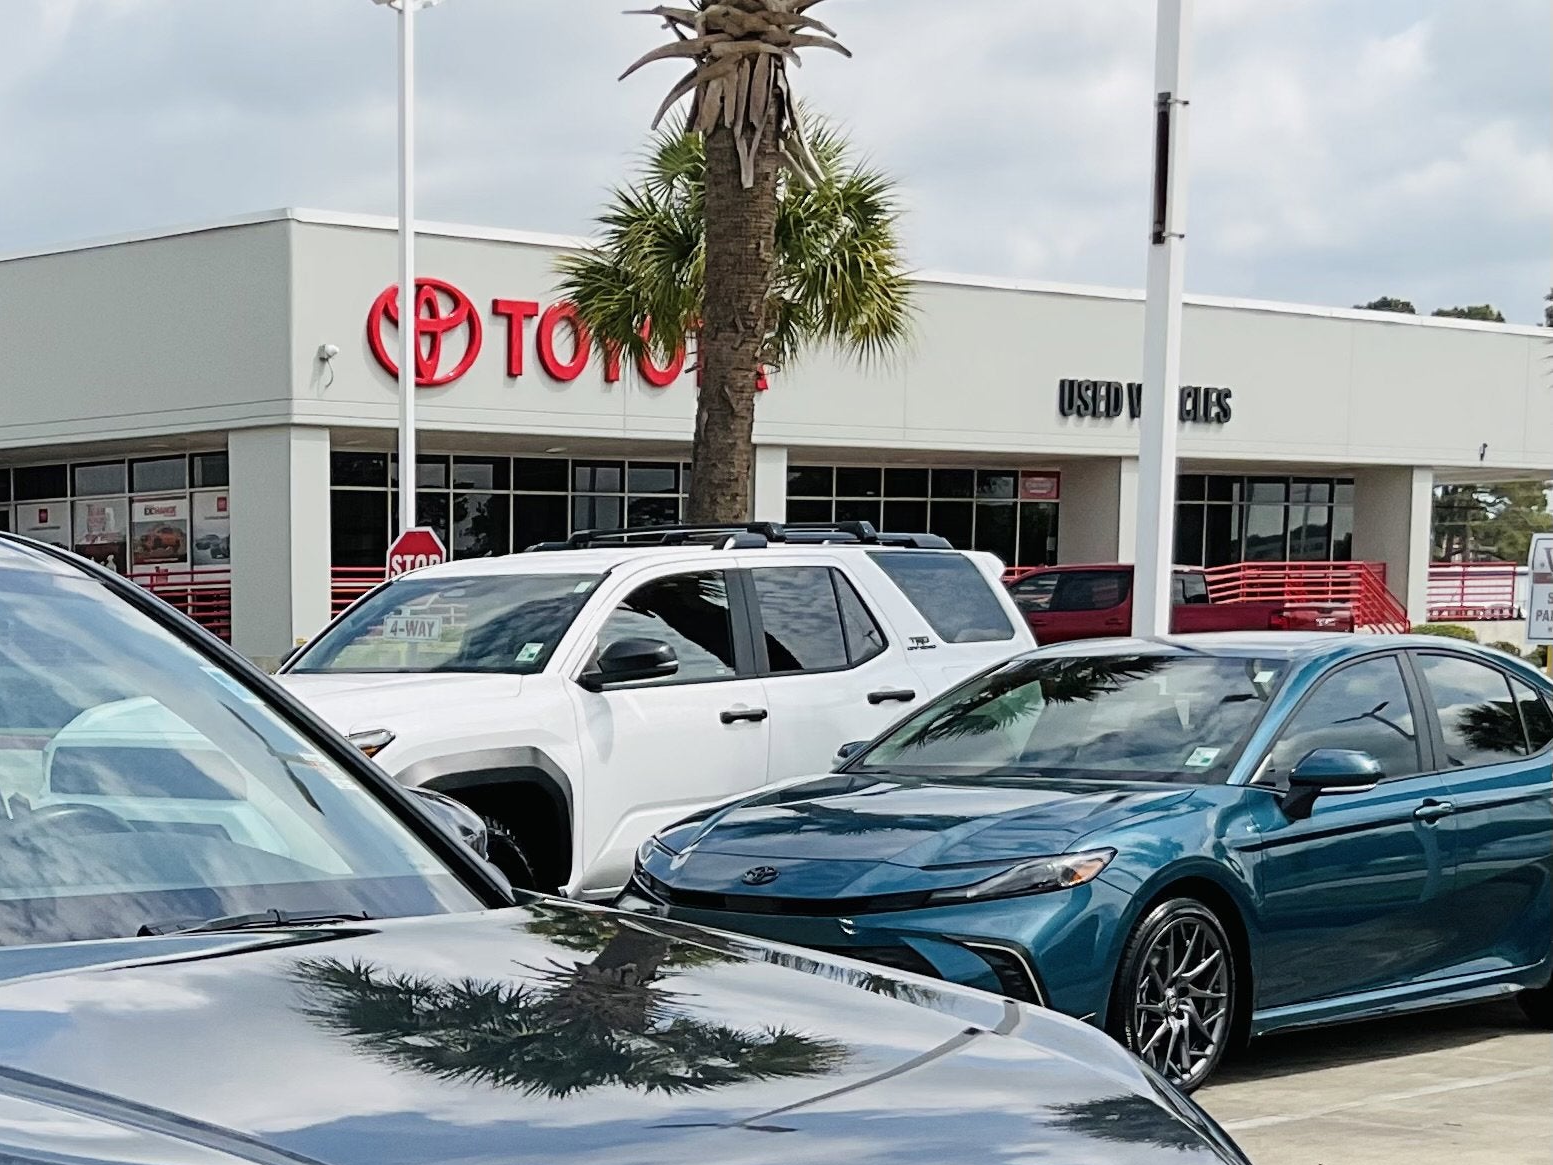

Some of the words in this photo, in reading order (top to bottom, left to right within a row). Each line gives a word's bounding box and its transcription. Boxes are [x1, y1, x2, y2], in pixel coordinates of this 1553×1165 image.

[492, 299, 768, 391] TOO
[1059, 379, 1123, 417] USED
[1127, 383, 1232, 423] VCLES
[389, 620, 435, 638] 4-WAY
